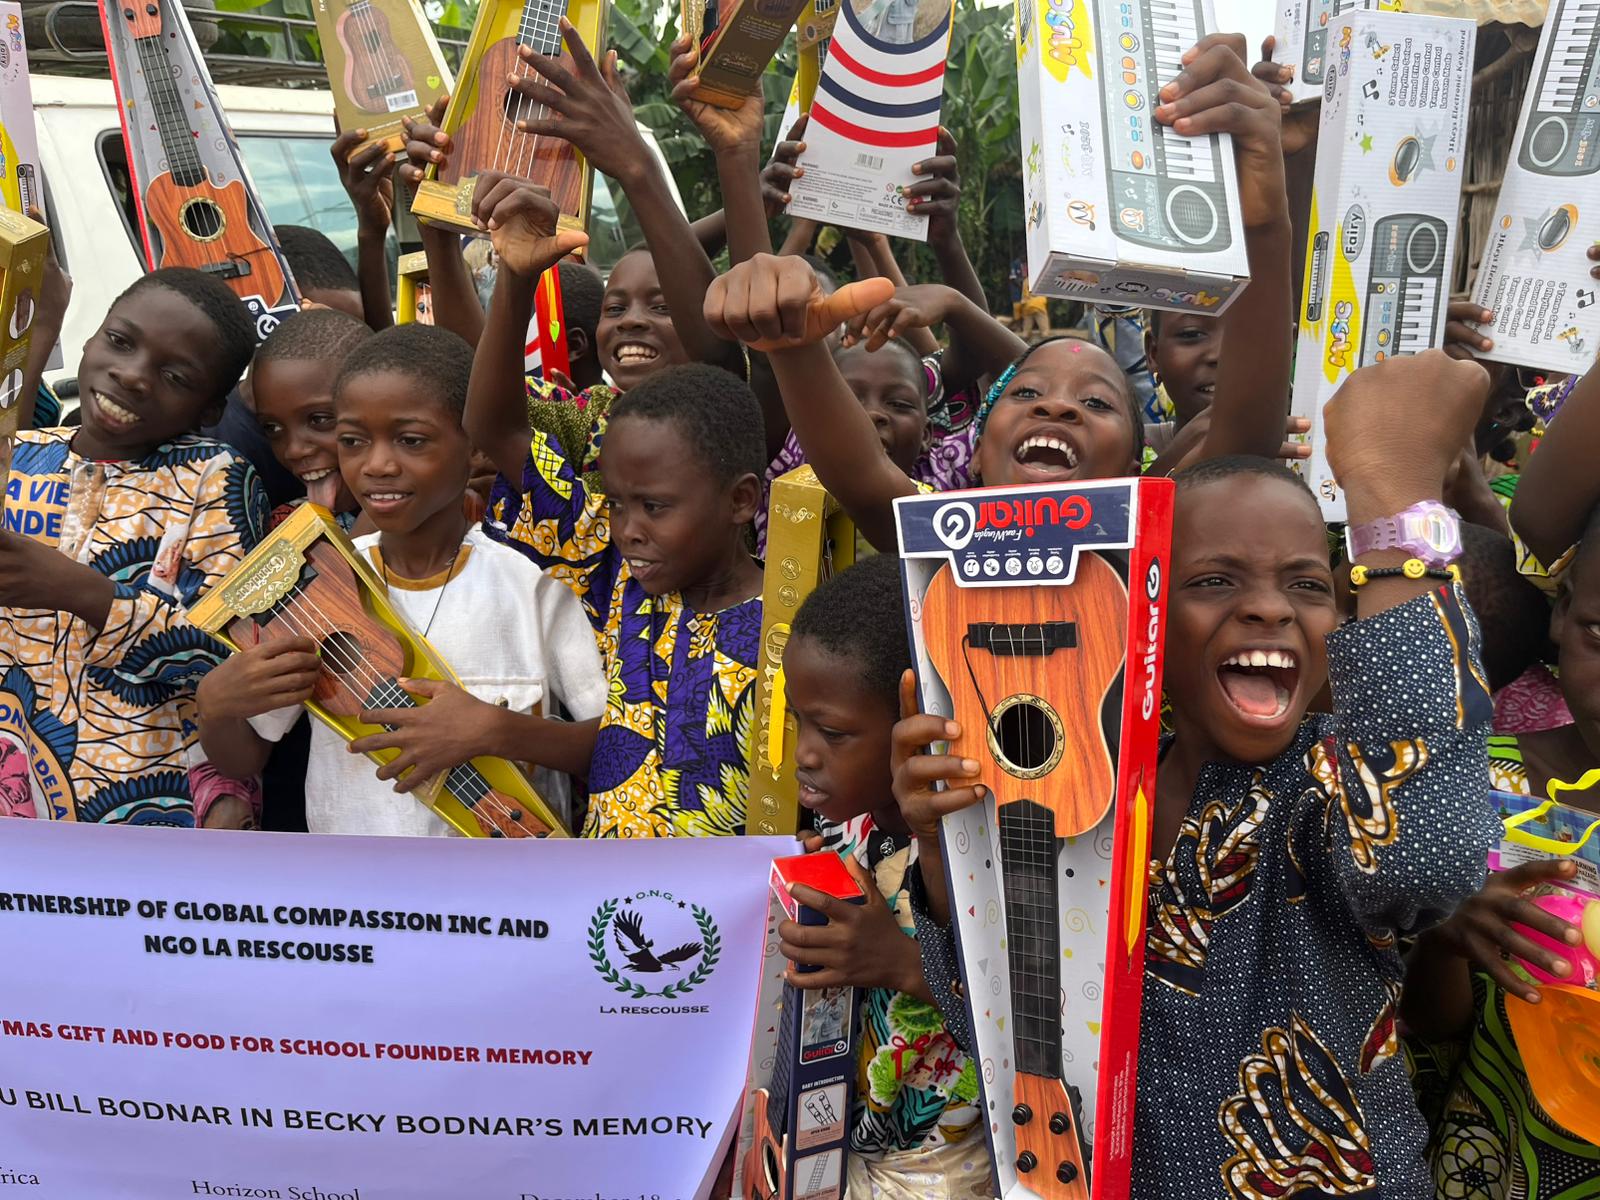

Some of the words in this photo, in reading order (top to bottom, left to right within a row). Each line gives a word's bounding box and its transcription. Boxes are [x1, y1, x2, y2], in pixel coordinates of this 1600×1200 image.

[1392, 44, 1401, 71] Select
[1403, 38, 1412, 66] Select
[1412, 52, 1421, 78] Effect
[1422, 43, 1432, 76] Control
[1432, 46, 1442, 78] Control
[1443, 52, 1452, 78] Mode
[1456, 30, 1466, 72] Keyboard
[1389, 72, 1398, 98] Tones
[1399, 66, 1410, 99] Rhythm
[1409, 79, 1418, 107] Sound
[1419, 76, 1429, 108] Volume
[1430, 80, 1440, 108] Tempo
[1440, 78, 1450, 109] Lesson
[1451, 74, 1462, 120] Electronic
[1345, 213, 1363, 254] Fairy
[1480, 264, 1498, 306] Electronic
[1507, 276, 1521, 306] Tempo
[1518, 278, 1534, 307] Volume
[1530, 279, 1544, 306] Sound
[1538, 287, 1554, 319] Rhythm
[1552, 288, 1566, 314] Tones
[1498, 305, 1513, 333] Control
[1508, 308, 1524, 337] Control
[1523, 306, 1536, 330] Effect
[1531, 318, 1544, 344] Select
[1544, 314, 1559, 340] Select
[1328, 300, 1352, 367] Music
[30, 480, 70, 506] VIE
[1, 507, 62, 538] NDE
[976, 494, 1092, 538] Guitar
[236, 554, 286, 602] Guitar
[1142, 604, 1159, 720] Guitar
[636, 890, 674, 903] O.N.G.
[0, 892, 131, 917] RTNERSHIP
[137, 900, 167, 919] OF
[174, 902, 268, 923] GLOBAL
[274, 906, 442, 932] COMPASSION
[448, 914, 492, 935] INC
[498, 918, 550, 938] AND
[144, 935, 197, 955] NGO
[202, 938, 232, 957] LA
[238, 940, 374, 964] RESCOUSSE
[600, 1006, 617, 1014] LA
[621, 1006, 710, 1014] RESCOUSSE
[0, 1020, 53, 1038] MAS
[58, 1024, 106, 1044] GIFT
[112, 1028, 158, 1046] AND
[163, 1032, 225, 1050] FOOD
[230, 1036, 275, 1053] FOR
[280, 1039, 370, 1058] SCHOOL
[375, 1043, 480, 1062] FOUNDER
[486, 1048, 593, 1066] MEMORY
[0, 1088, 18, 1106] U
[25, 1090, 92, 1114] BILL
[98, 1097, 232, 1126] BODNAR
[240, 1108, 273, 1128] IN
[284, 1110, 386, 1132] BECKY
[396, 1115, 563, 1136] BODNAR'S
[572, 1116, 712, 1139] MEMORY
[0, 1167, 40, 1184] rica
[191, 1180, 280, 1199] Horizon
[288, 1186, 360, 1200] School
